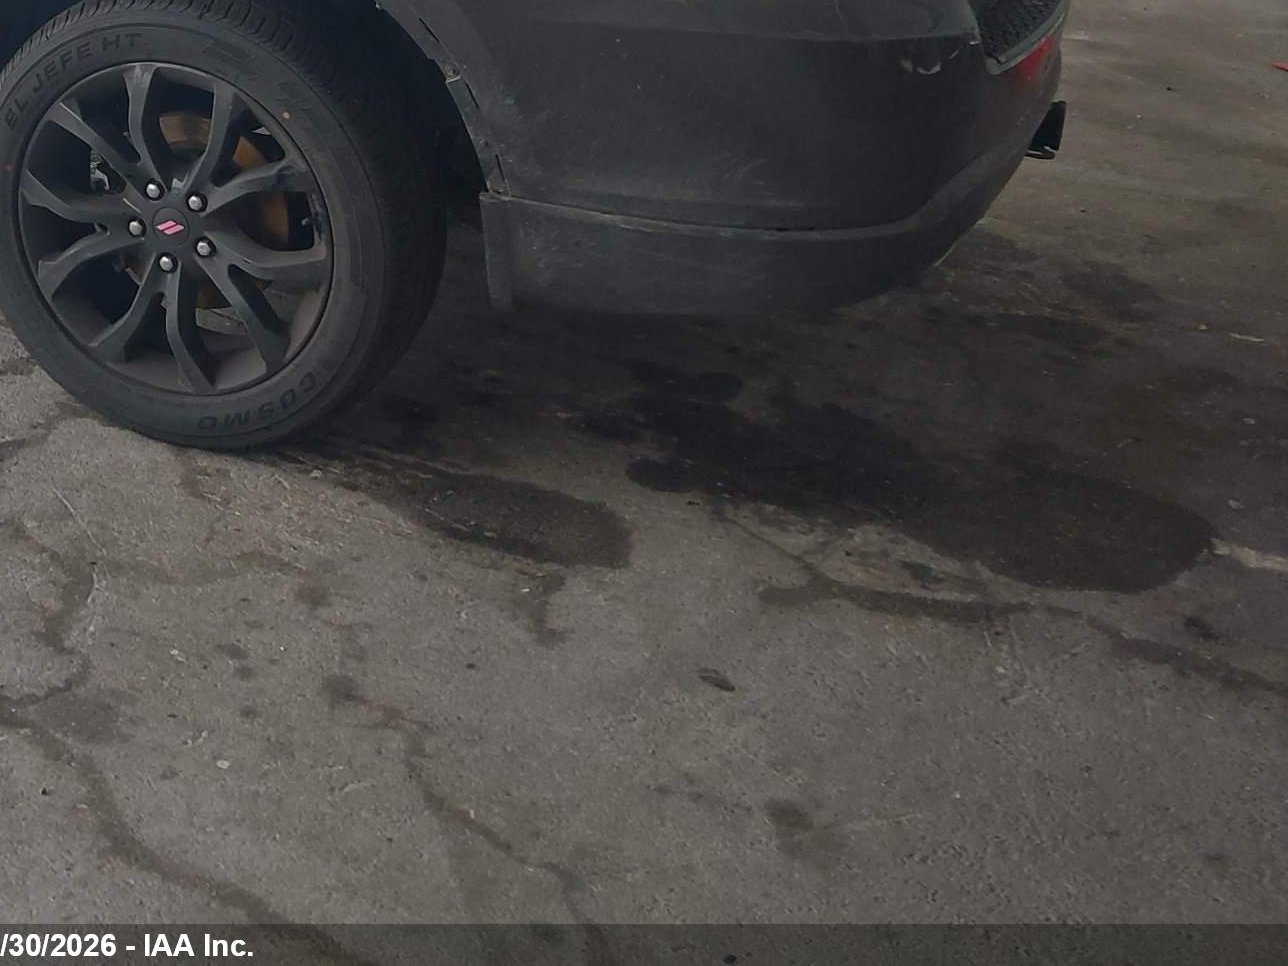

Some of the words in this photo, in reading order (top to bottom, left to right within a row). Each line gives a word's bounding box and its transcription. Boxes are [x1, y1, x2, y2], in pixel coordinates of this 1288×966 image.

[4, 99, 29, 128] EL
[32, 41, 93, 94] JEFE
[102, 33, 143, 51] HT
[198, 372, 316, 430] COSMO
